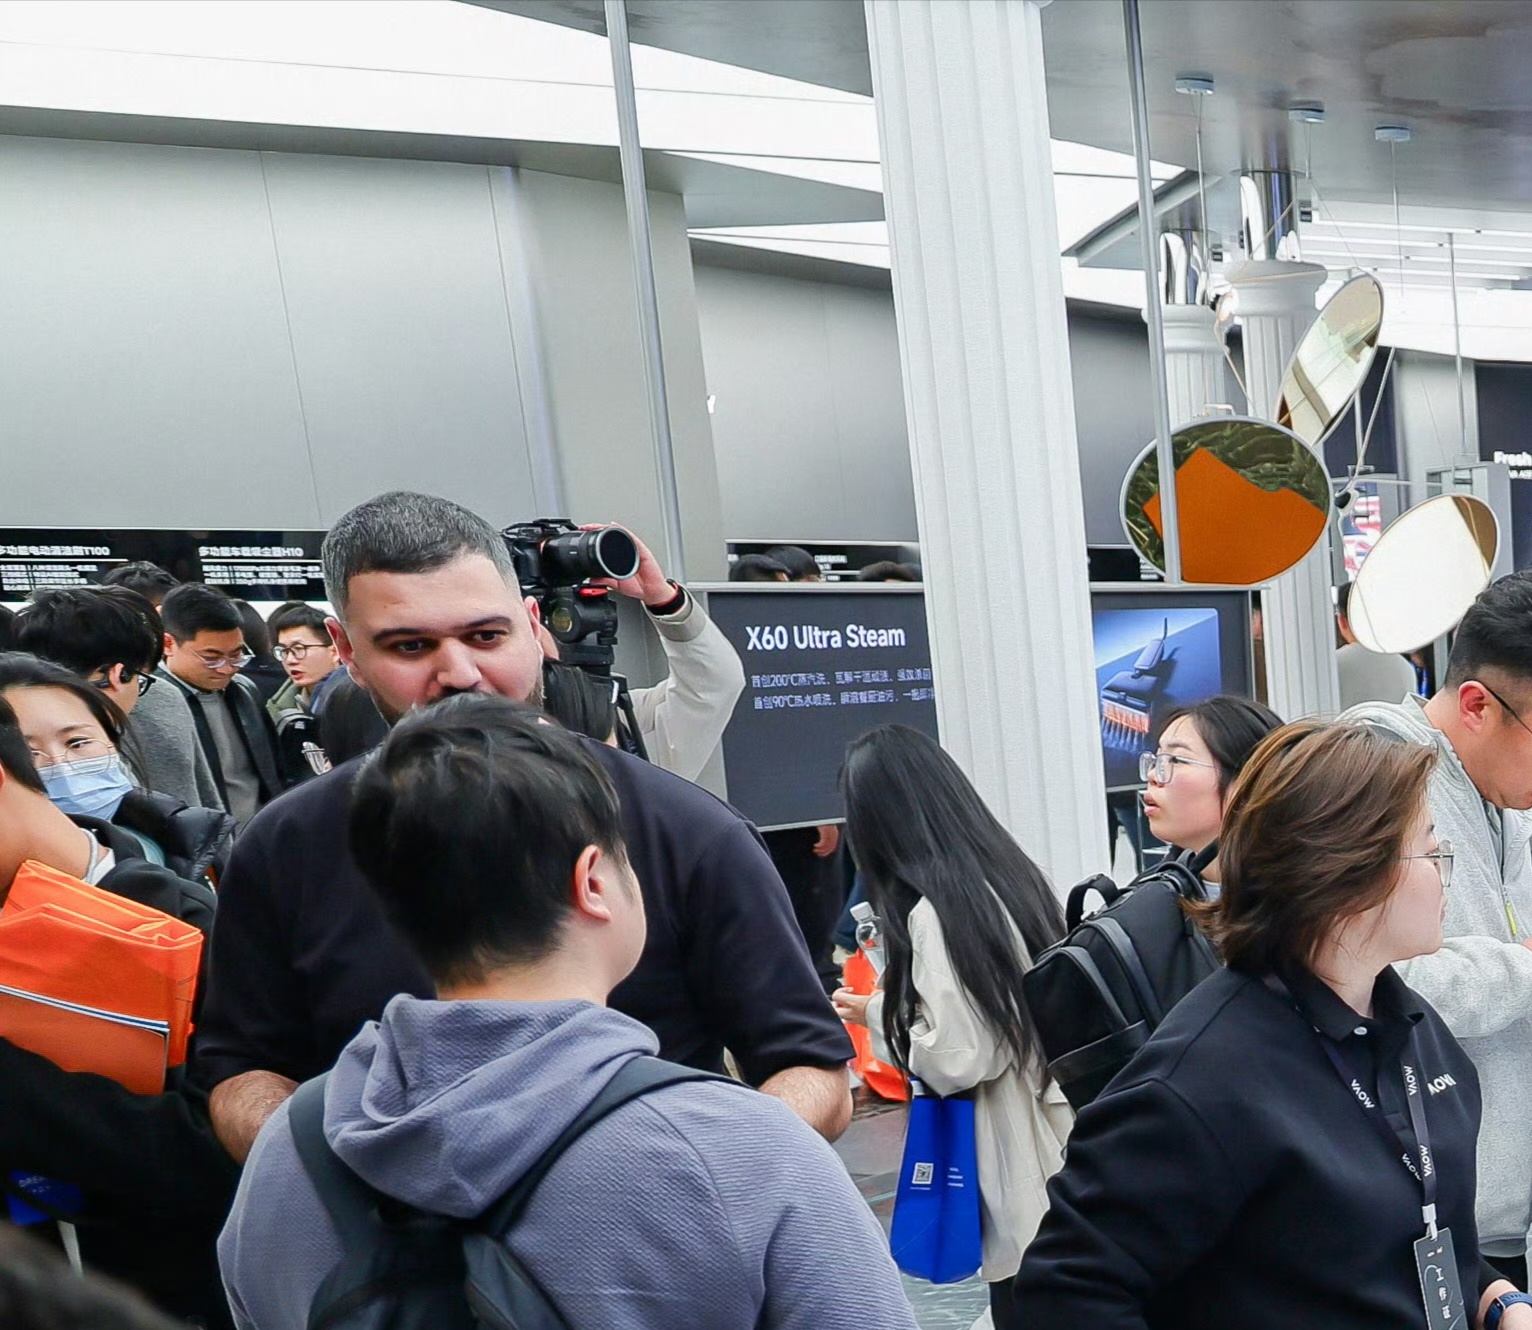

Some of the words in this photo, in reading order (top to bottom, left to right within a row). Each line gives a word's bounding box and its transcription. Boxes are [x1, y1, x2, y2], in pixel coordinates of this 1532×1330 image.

[746, 625, 789, 650] X60
[793, 625, 843, 649] Ultra
[846, 624, 907, 647] Steam
[1350, 1079, 1375, 1109] MOVA
[1403, 1065, 1418, 1096] MOVA
[1420, 1145, 1433, 1177] MOVA
